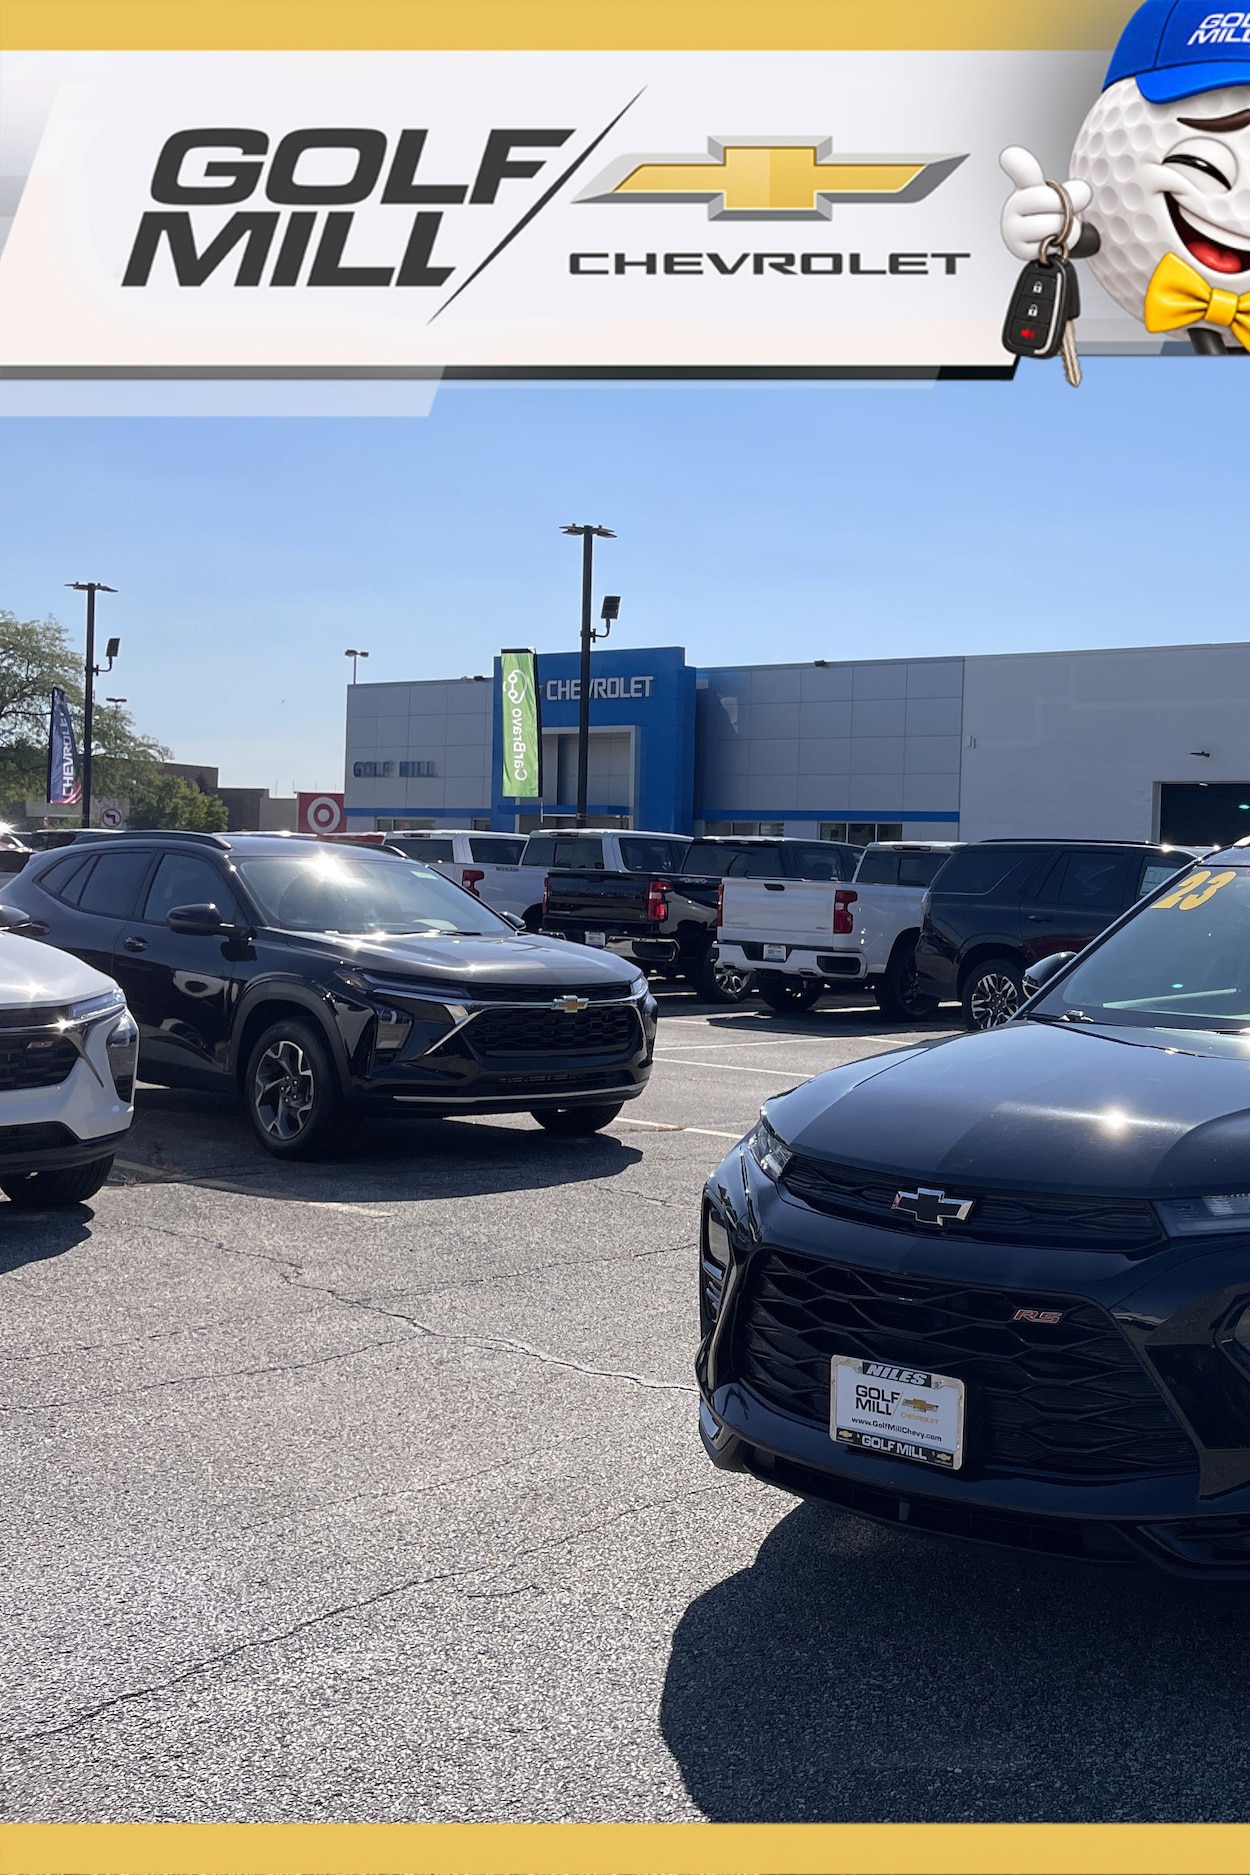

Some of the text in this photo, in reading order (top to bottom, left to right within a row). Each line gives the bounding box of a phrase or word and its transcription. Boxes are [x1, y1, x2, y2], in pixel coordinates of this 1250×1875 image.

[353, 760, 436, 777] GOLF MILL
[1150, 870, 1237, 911] 23
[1013, 1309, 1063, 1324] RS
[865, 1364, 928, 1386] NILES
[855, 1384, 901, 1404] GOLF
[855, 1397, 892, 1416] MILL
[900, 1411, 940, 1426] CHEVROLET
[851, 1417, 942, 1442] www.GolfMillChevy.com
[861, 1435, 928, 1461] GOLF MILL
